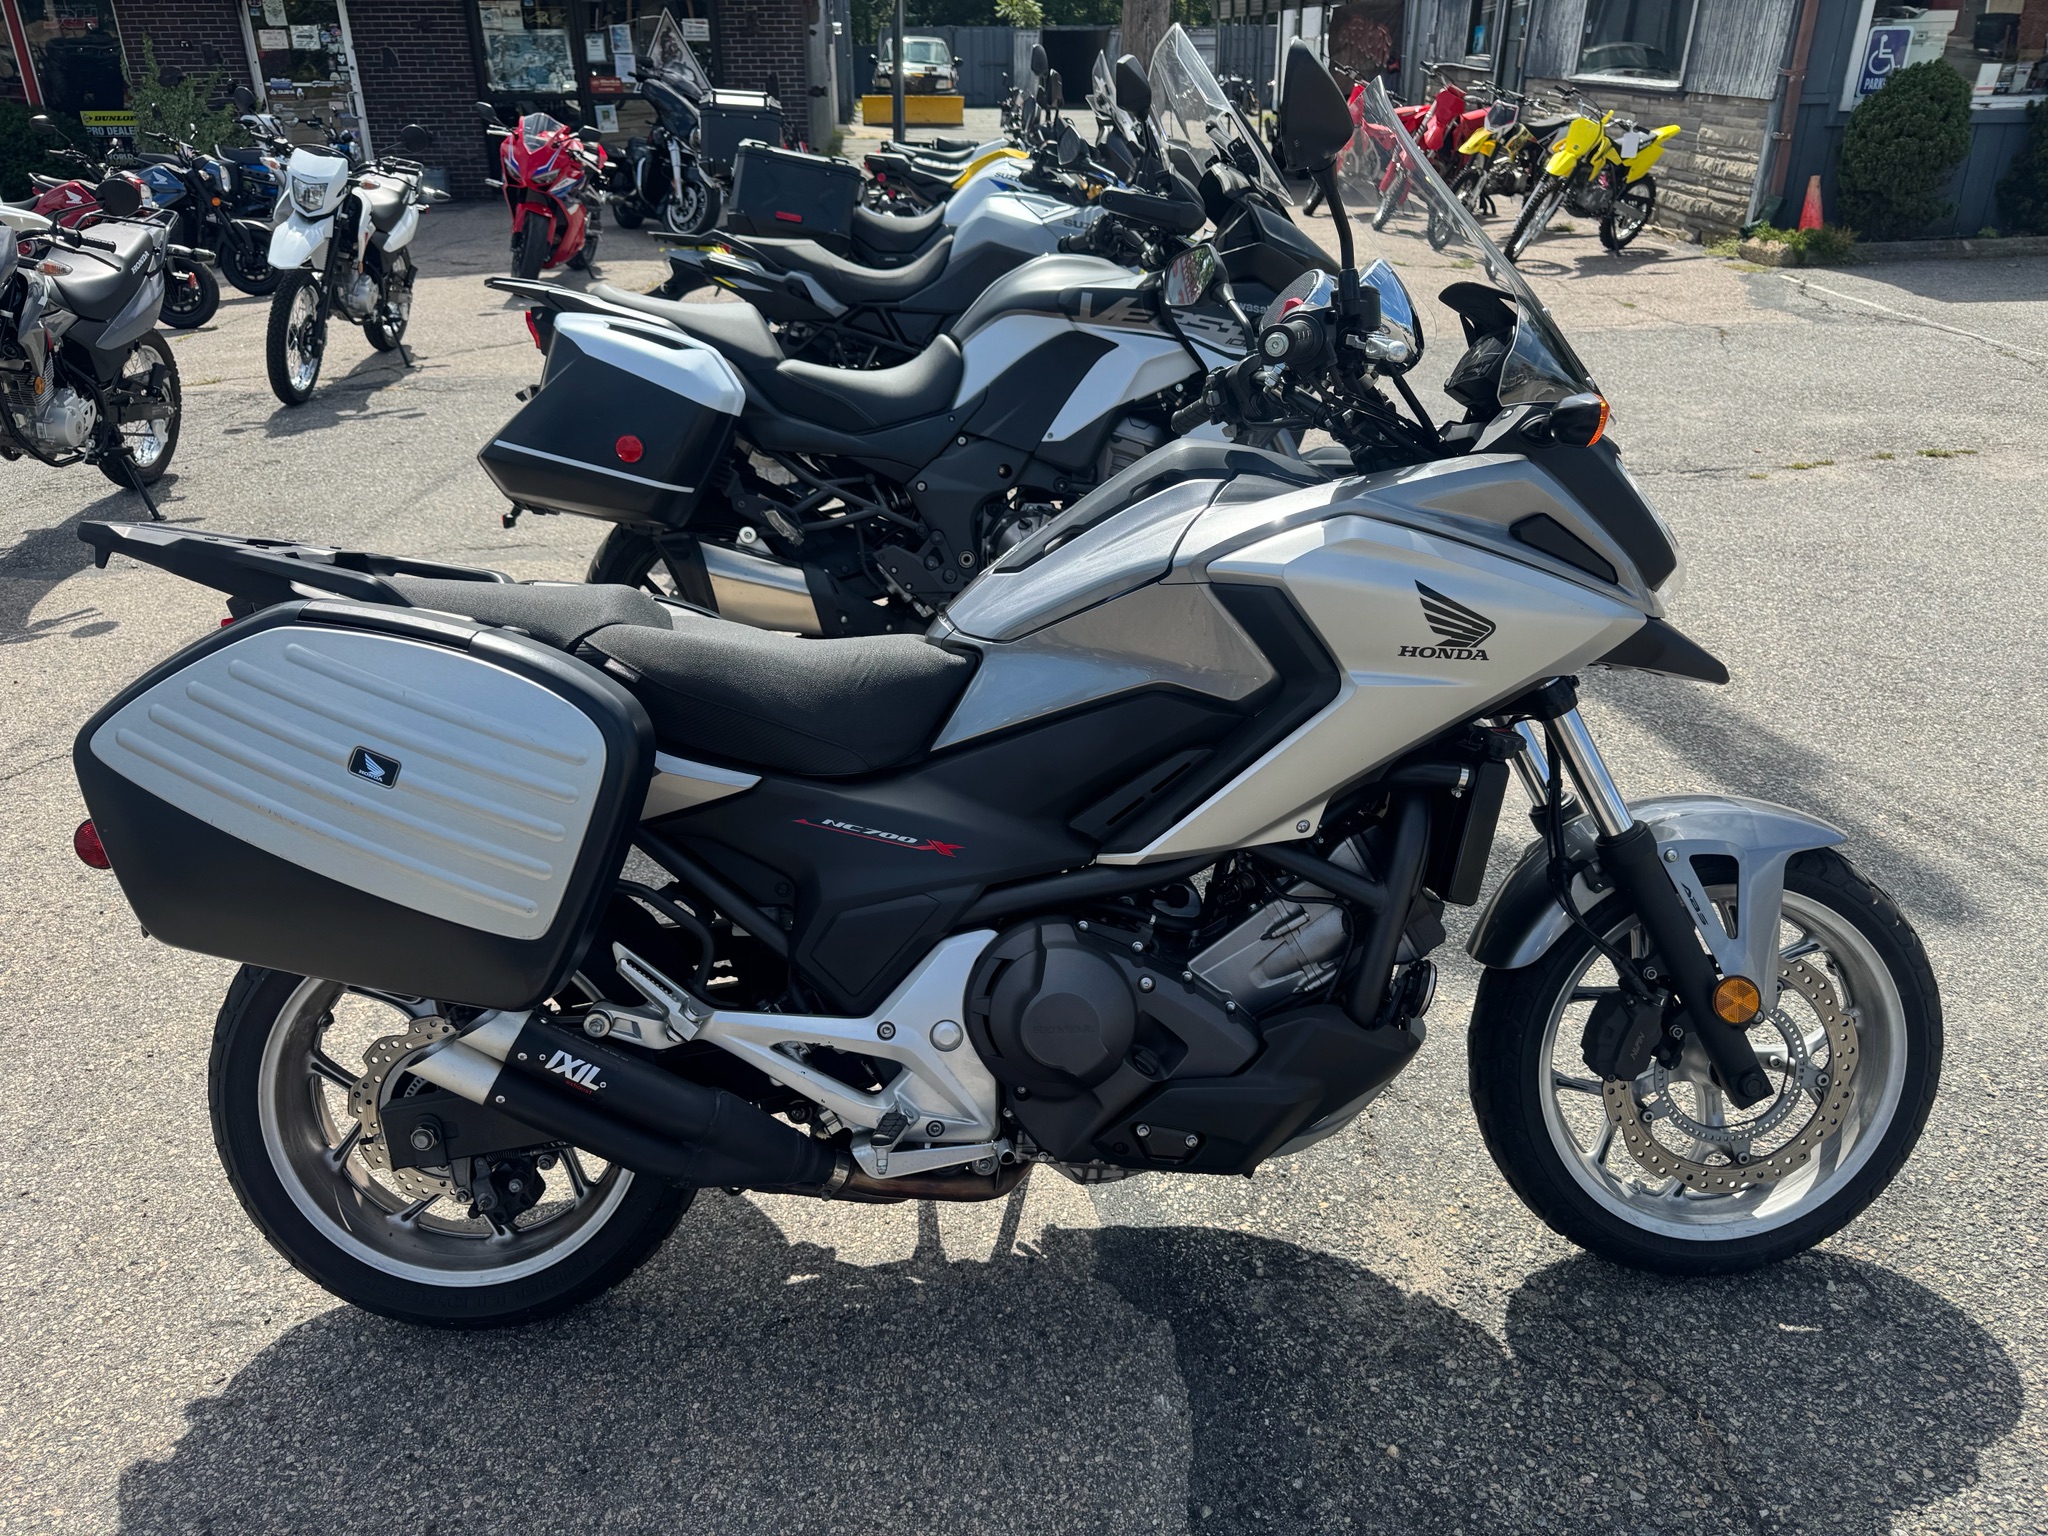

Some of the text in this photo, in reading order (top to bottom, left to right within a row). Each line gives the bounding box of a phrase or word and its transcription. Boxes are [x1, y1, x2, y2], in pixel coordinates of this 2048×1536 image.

[131, 250, 150, 275] HONDA
[1398, 645, 1490, 661] HONDA
[358, 769, 383, 782] HONDA
[1681, 882, 1709, 925] ABS
[544, 1049, 601, 1091] IXIL
